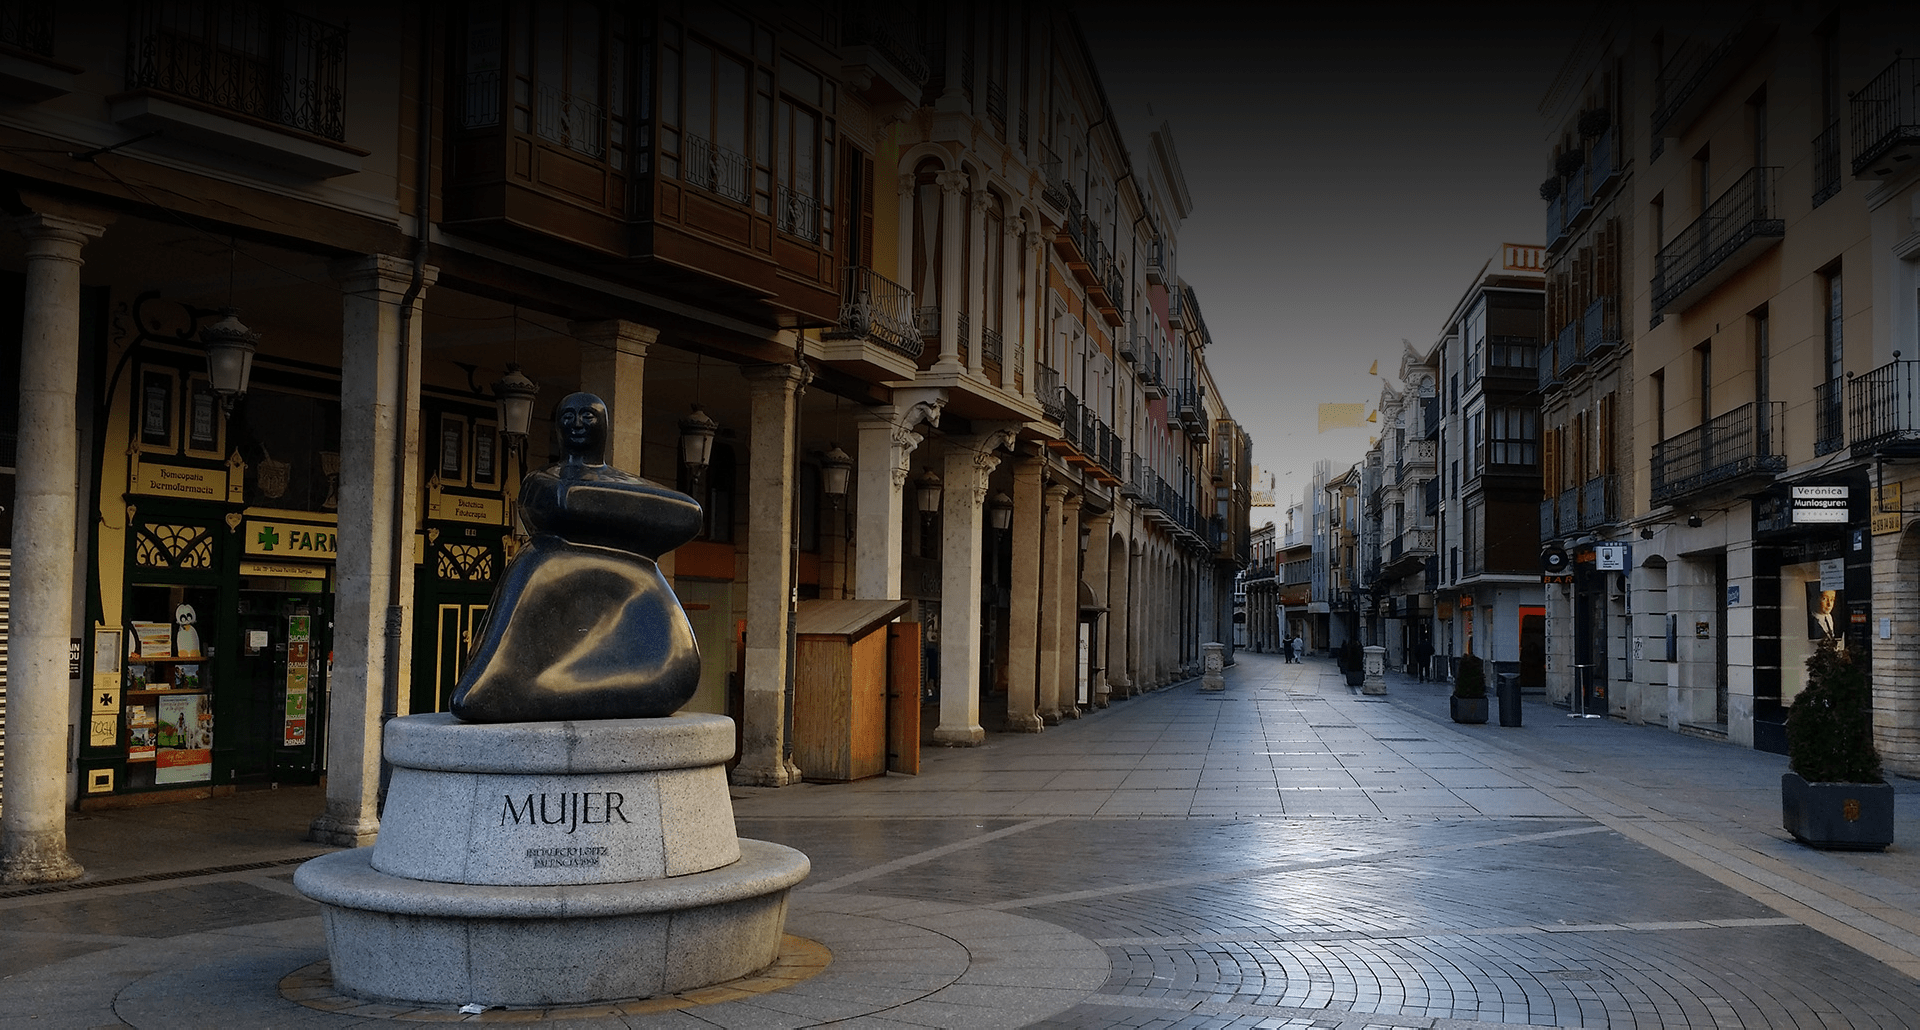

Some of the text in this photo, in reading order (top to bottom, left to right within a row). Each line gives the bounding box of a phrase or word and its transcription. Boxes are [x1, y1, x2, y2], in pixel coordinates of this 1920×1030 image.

[1797, 486, 1843, 495] Verónica
[1544, 575, 1574, 584] BAR
[500, 791, 632, 835] MUJER
